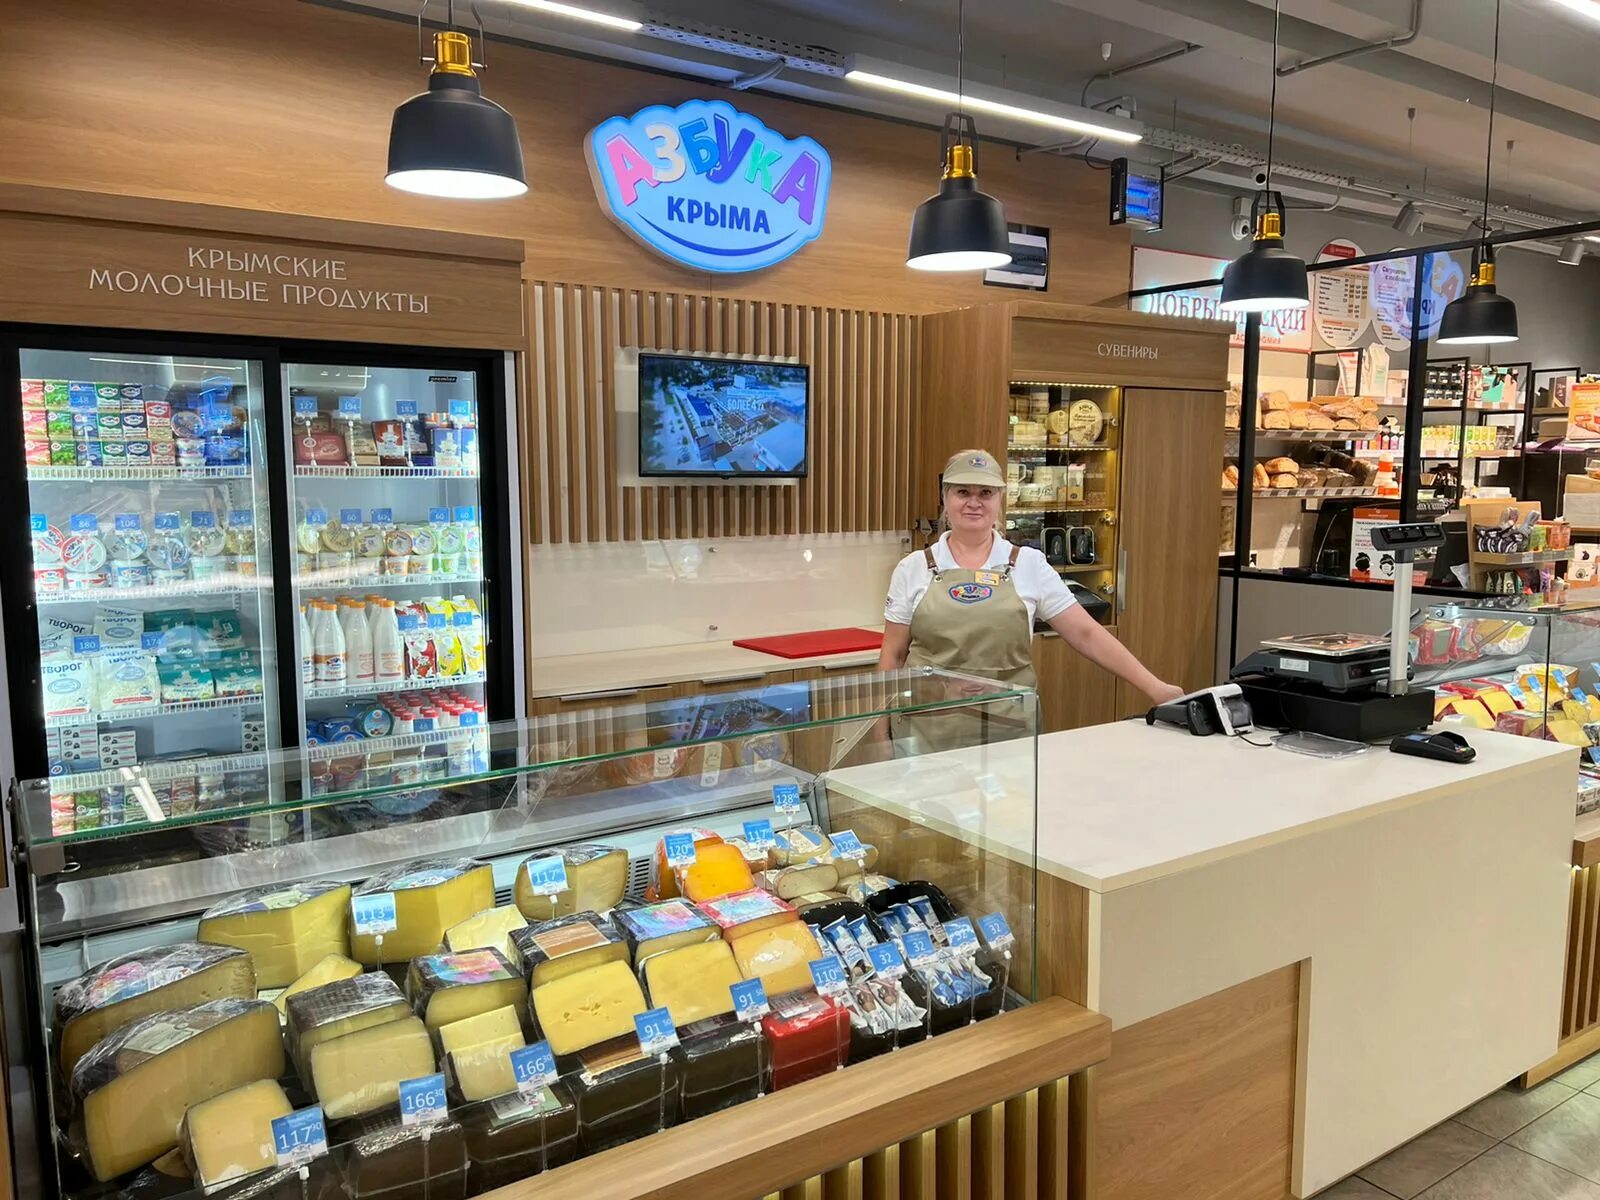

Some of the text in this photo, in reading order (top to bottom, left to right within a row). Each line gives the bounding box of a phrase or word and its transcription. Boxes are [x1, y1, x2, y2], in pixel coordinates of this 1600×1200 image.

[606, 113, 820, 225] АЗБУКА
[667, 196, 770, 234] КРЫМА
[187, 247, 347, 281] КРЫМСКИЕ
[88, 268, 429, 314] МОЛОЧНЫЕ ПРОДУКТЫ
[1097, 343, 1158, 360] СУВЕНИРЫ
[79, 520, 90, 528] 86
[49, 618, 85, 634] ТВОРОГ
[79, 641, 96, 650] 180
[41, 662, 83, 675] ТВОРОГ
[776, 793, 794, 805] 128
[748, 828, 767, 841] 117
[669, 844, 688, 857] 120
[535, 869, 556, 883] 117
[360, 908, 385, 921] 113
[989, 922, 1002, 935] 32
[912, 940, 926, 953] 32
[879, 952, 893, 965] 32
[815, 969, 837, 985] 110
[738, 992, 755, 1008] 91
[643, 1022, 662, 1038] 91
[517, 1057, 546, 1079] 166
[405, 1087, 445, 1111] 166 30
[279, 1125, 312, 1150] 117
